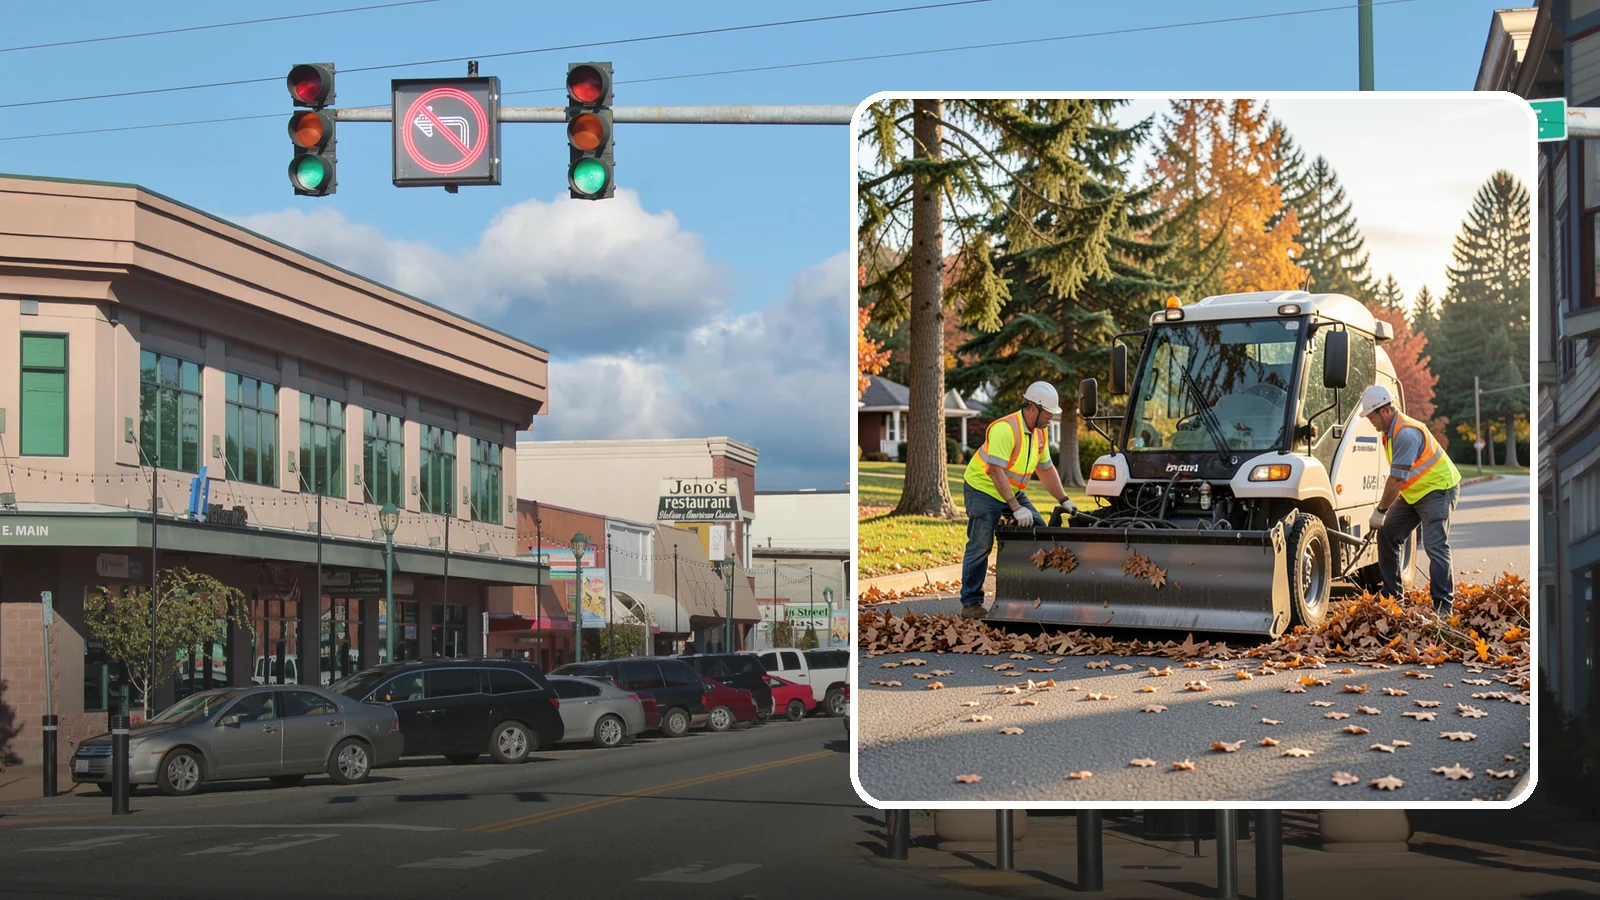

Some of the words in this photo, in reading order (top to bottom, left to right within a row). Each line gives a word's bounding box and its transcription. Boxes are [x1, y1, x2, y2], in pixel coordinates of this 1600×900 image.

[670, 480, 727, 495] Jeno's
[665, 496, 731, 509] restaurant
[658, 509, 681, 519] Italian
[686, 509, 714, 519] American
[715, 509, 738, 519] Cuisine
[2, 525, 13, 536] E.
[15, 525, 49, 536] MAIN
[797, 607, 828, 616] Street
[791, 619, 824, 627] lass
